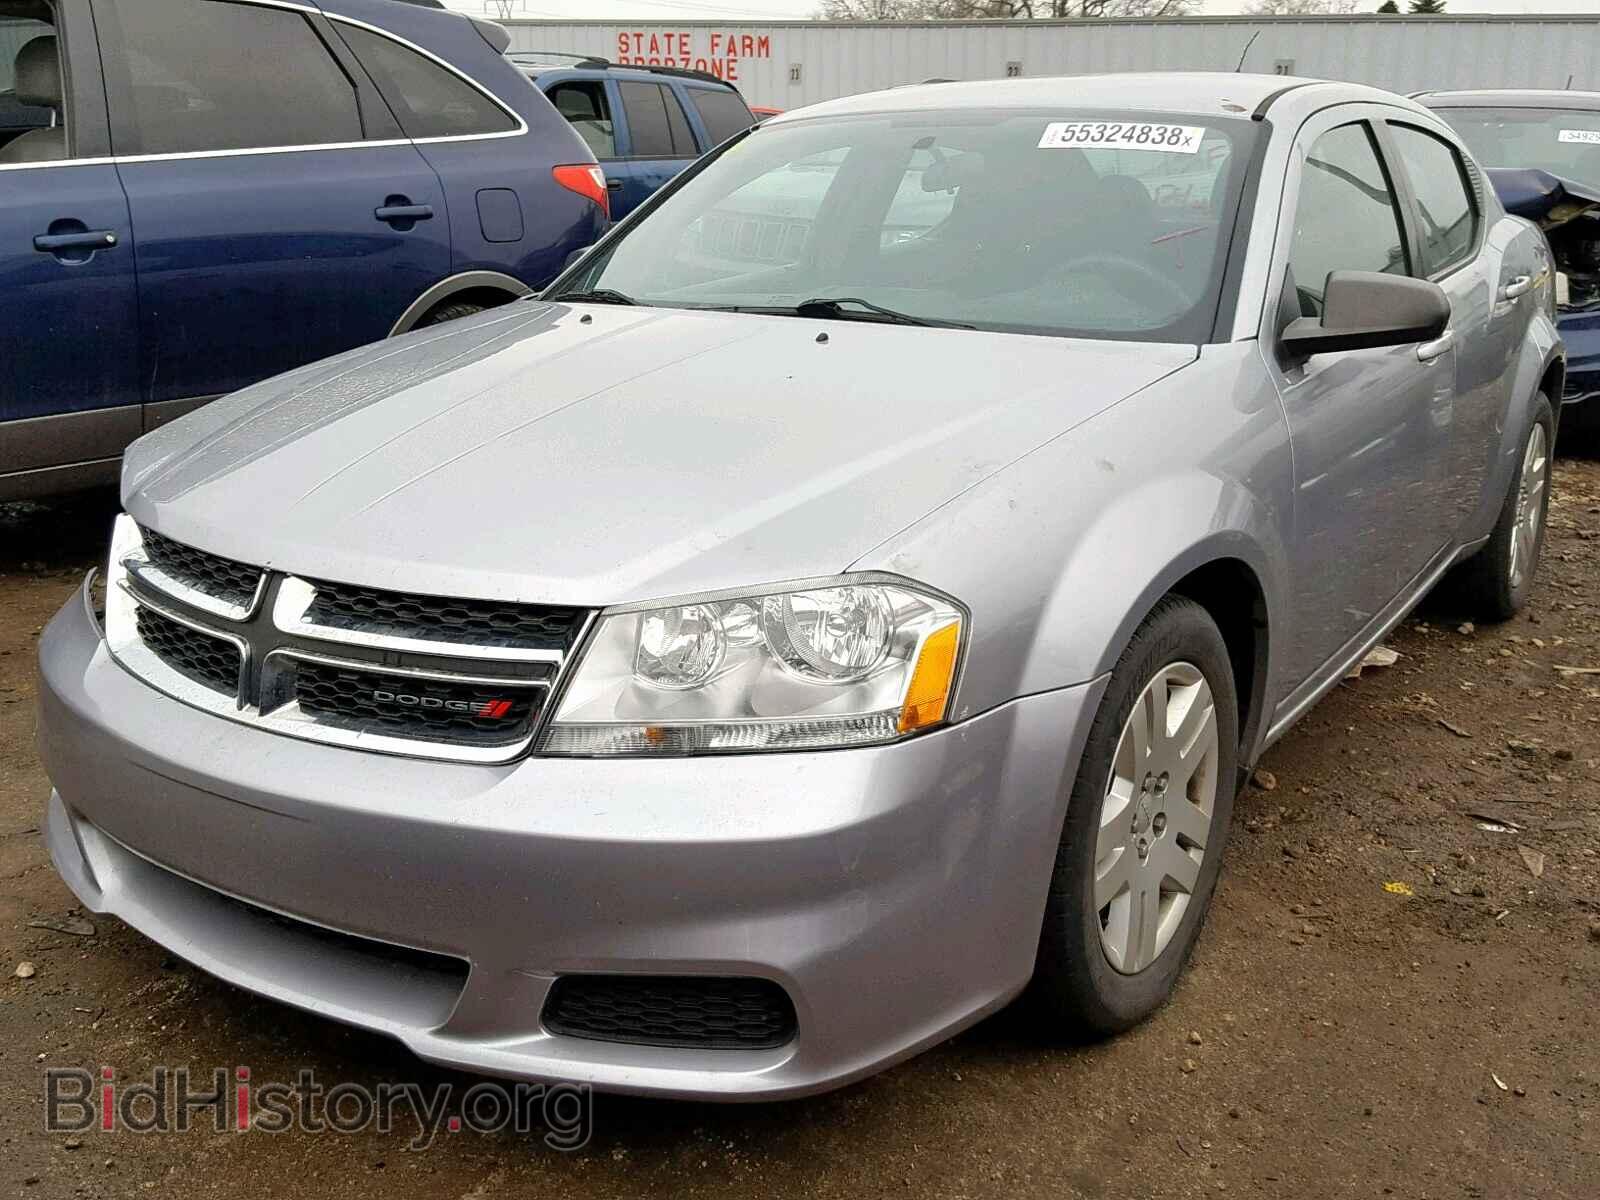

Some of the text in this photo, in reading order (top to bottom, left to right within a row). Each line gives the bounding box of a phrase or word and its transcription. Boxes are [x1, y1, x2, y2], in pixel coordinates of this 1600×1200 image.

[618, 32, 770, 58] STATE FARM
[374, 691, 493, 713] DODGE
